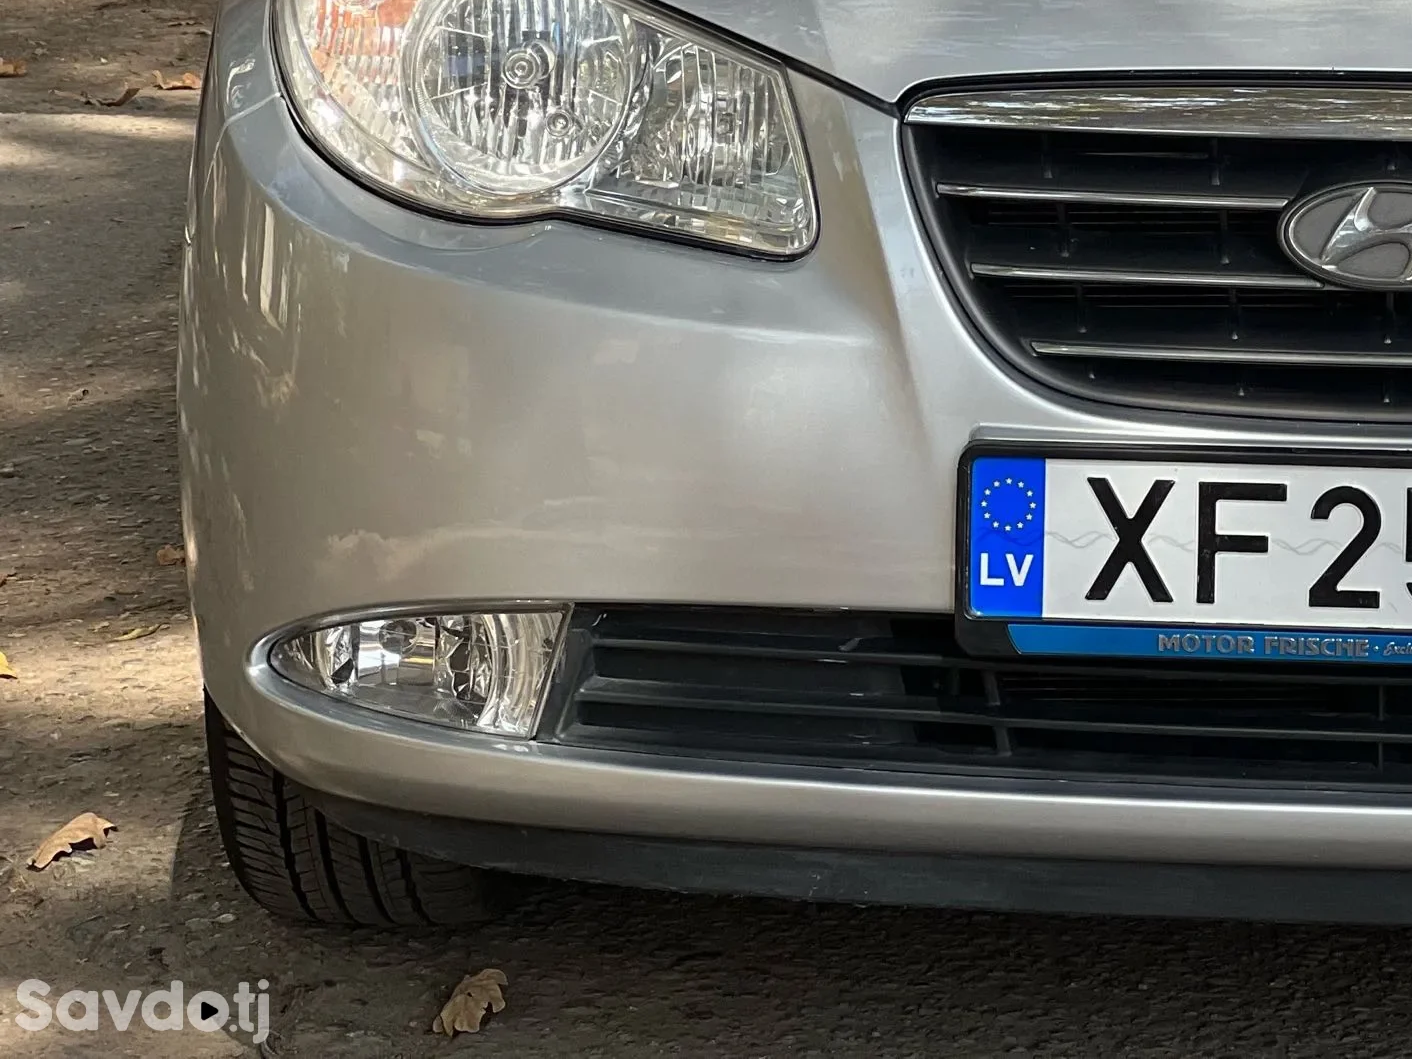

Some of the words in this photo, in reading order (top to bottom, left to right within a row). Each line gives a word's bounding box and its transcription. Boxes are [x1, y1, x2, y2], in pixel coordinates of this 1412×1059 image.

[980, 553, 1034, 587] LV
[1157, 634, 1254, 653] MOTOR
[1264, 636, 1369, 657] FRISCHE
